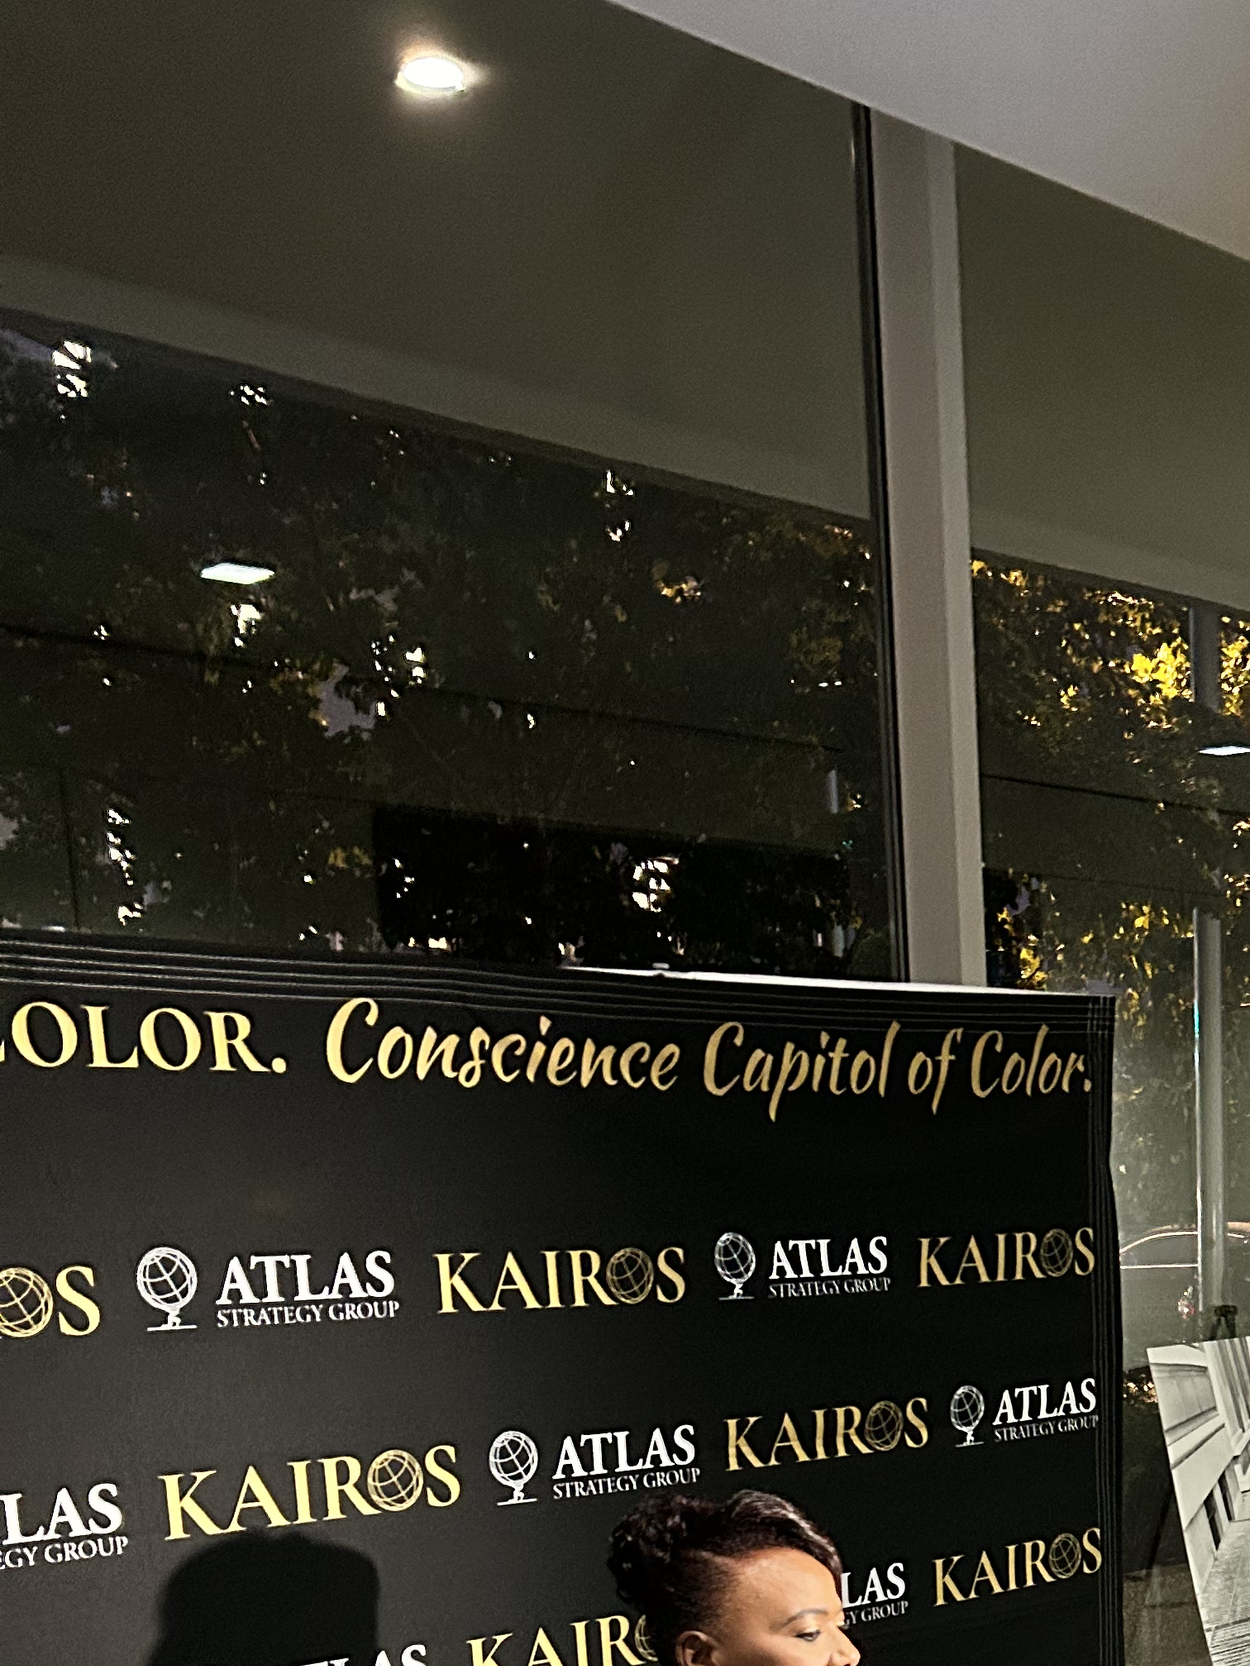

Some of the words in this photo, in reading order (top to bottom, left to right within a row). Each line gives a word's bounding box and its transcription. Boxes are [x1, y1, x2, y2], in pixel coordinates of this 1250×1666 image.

[0, 1001, 287, 1074] OLOR.
[326, 997, 681, 1091] Conscience
[703, 1020, 901, 1122] Capitol
[907, 1026, 963, 1115] of
[970, 1023, 1093, 1097] Color.
[215, 1250, 396, 1305] ATLAS
[434, 1246, 686, 1314] KAIROS
[769, 1236, 888, 1281] ATLAS
[916, 1226, 1096, 1289] KAIROS
[216, 1305, 325, 1328] STRATEGY
[328, 1300, 400, 1321] GROUP
[768, 1280, 842, 1298] STRATEGY
[844, 1277, 891, 1295] GROUP
[993, 1378, 1097, 1426] ATLAS
[994, 1421, 1056, 1442] STRATEGY
[1057, 1415, 1099, 1434] GROUP
[552, 1424, 696, 1481] ATLAS
[723, 1397, 928, 1472] KAIROS
[157, 1444, 462, 1541] KAIROS
[553, 1473, 639, 1500] STRATEGY
[642, 1467, 701, 1489] GROUP
[44, 1535, 129, 1564] GROUP
[933, 1527, 1102, 1606] KAIROS
[859, 1601, 908, 1624] GROUP
